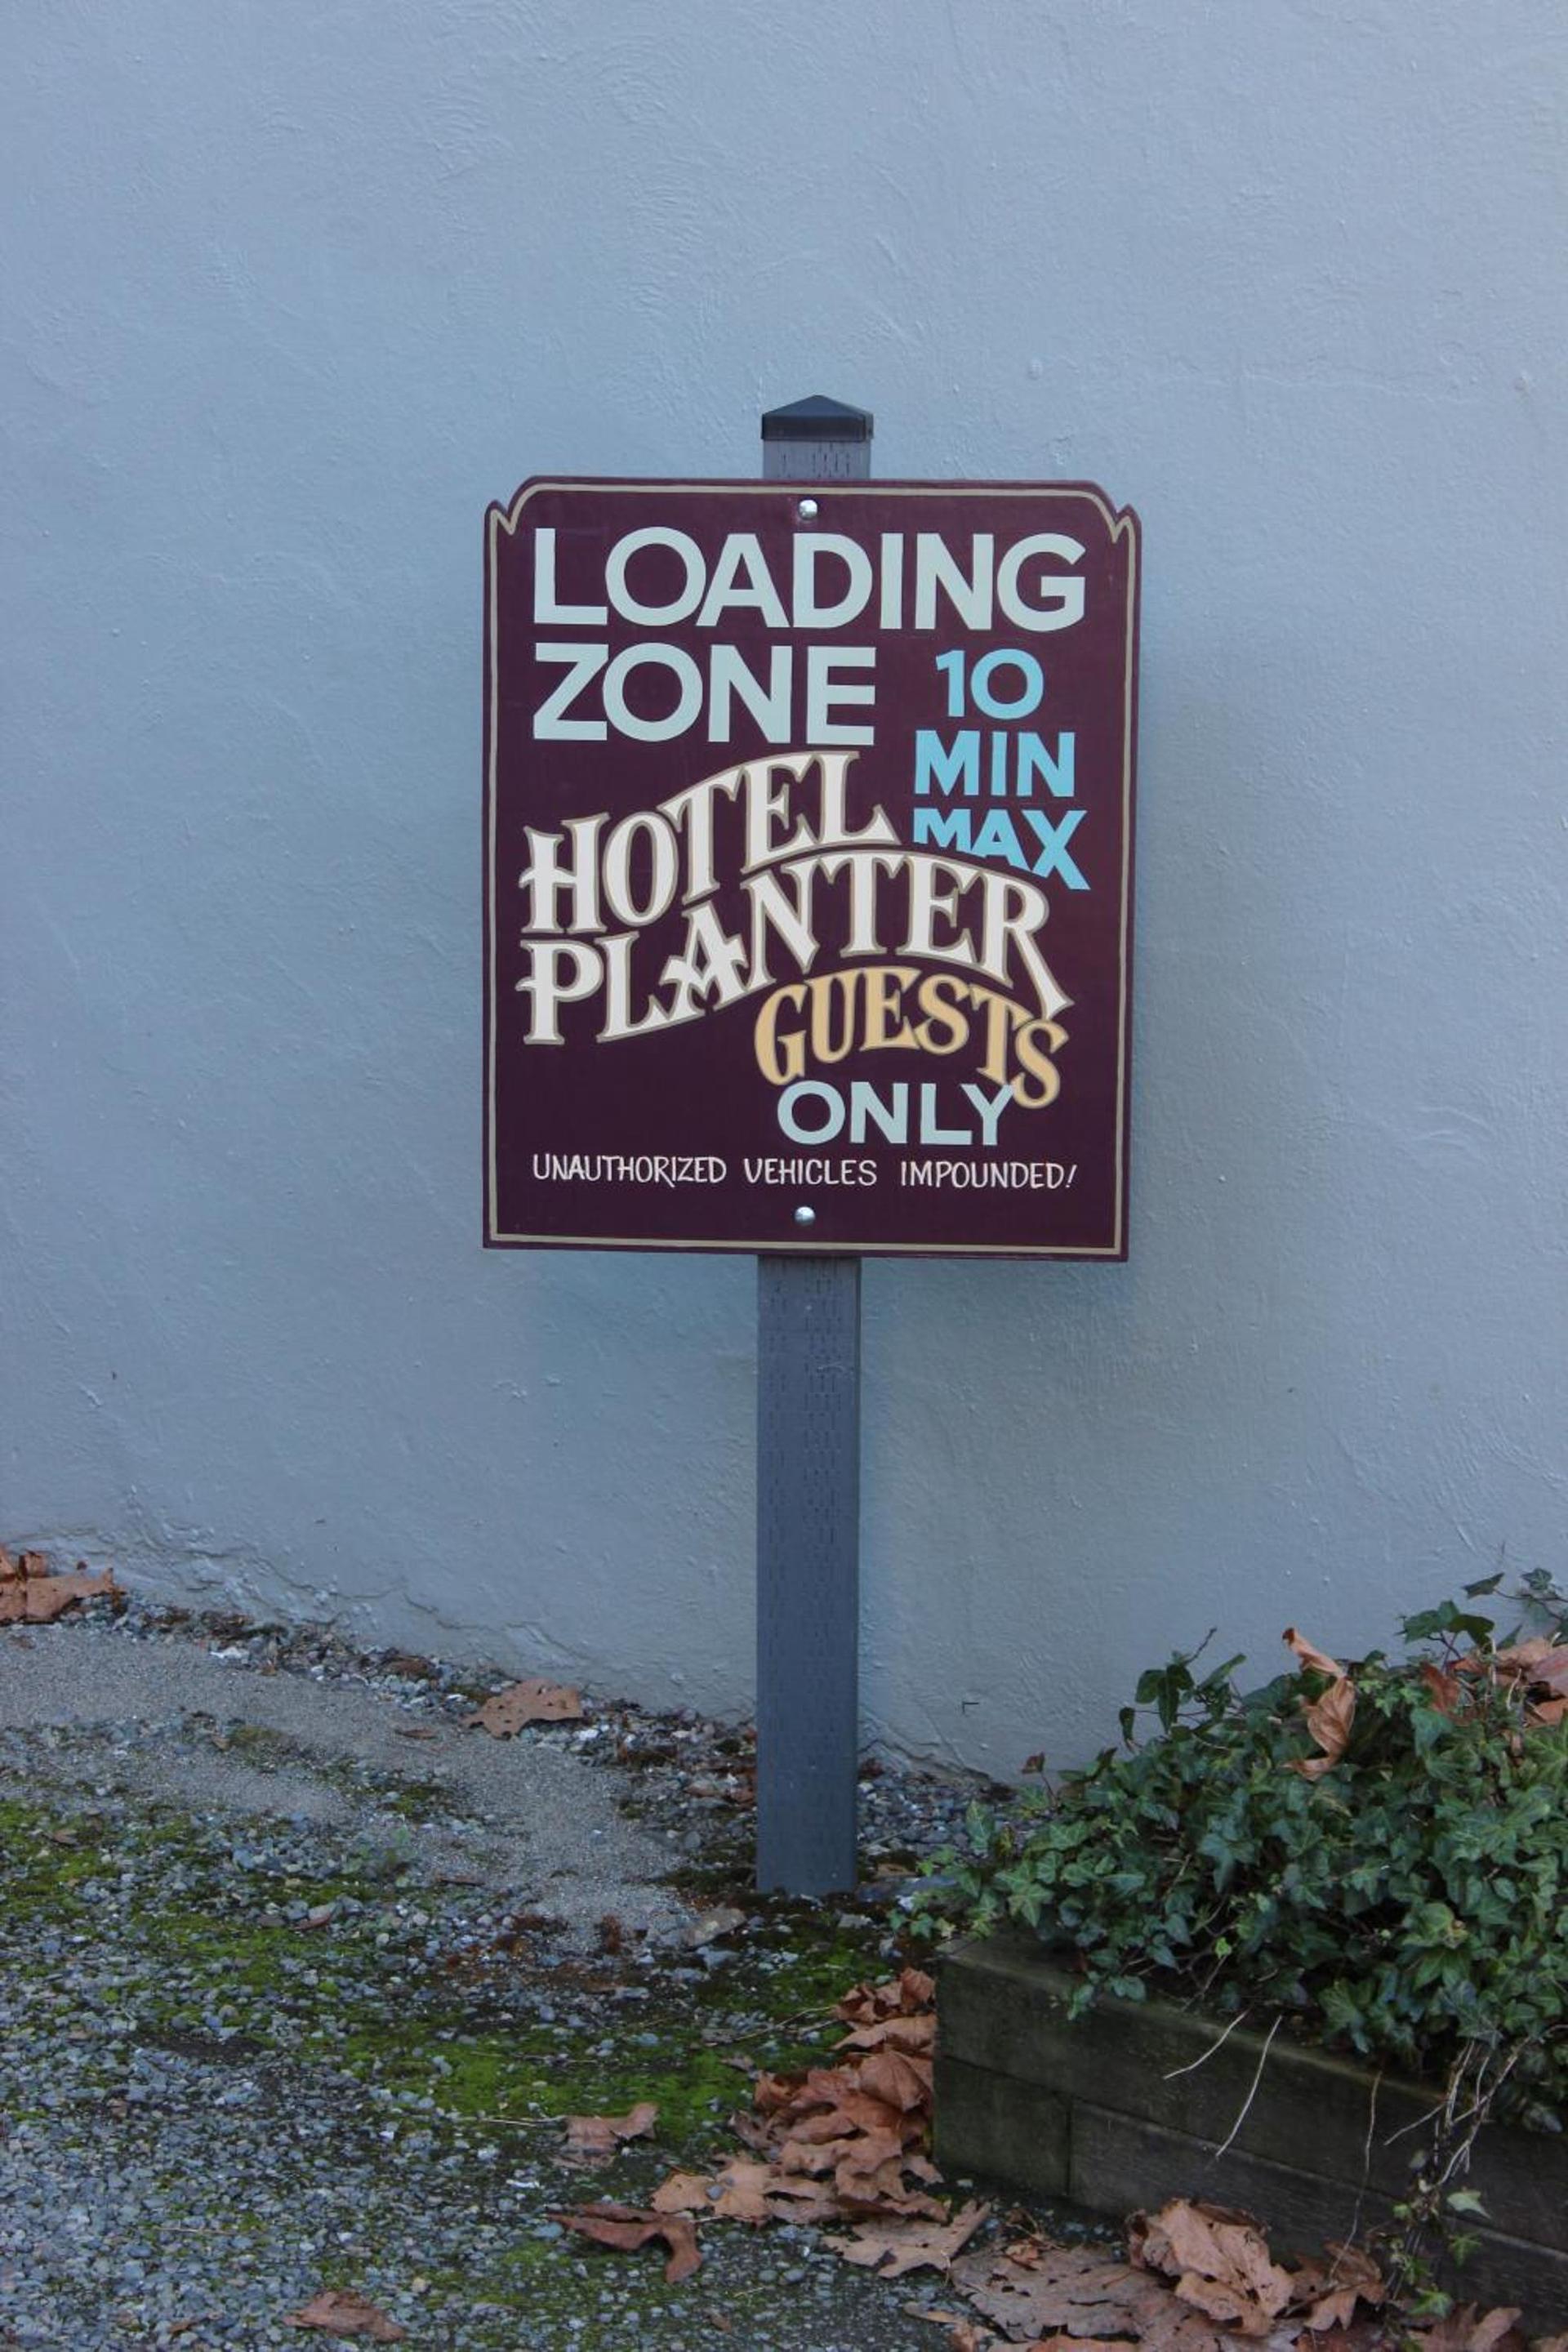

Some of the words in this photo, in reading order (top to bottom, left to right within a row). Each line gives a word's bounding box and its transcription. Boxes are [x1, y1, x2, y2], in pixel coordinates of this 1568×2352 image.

[533, 526, 1086, 632] LOADING
[533, 642, 876, 745] ZONE
[935, 648, 1045, 719] 10
[915, 729, 1076, 798] MIN
[519, 751, 901, 934] HOTEL
[913, 808, 1091, 890] MAX
[515, 849, 1075, 1045] PLANTER
[754, 966, 1070, 1109] GUESTS
[777, 1080, 1017, 1146] ONLY
[532, 1153, 727, 1188] UNAUTHORIZED
[743, 1158, 877, 1187] VEHICLES
[900, 1160, 1078, 1189] IMPOUNDED!
